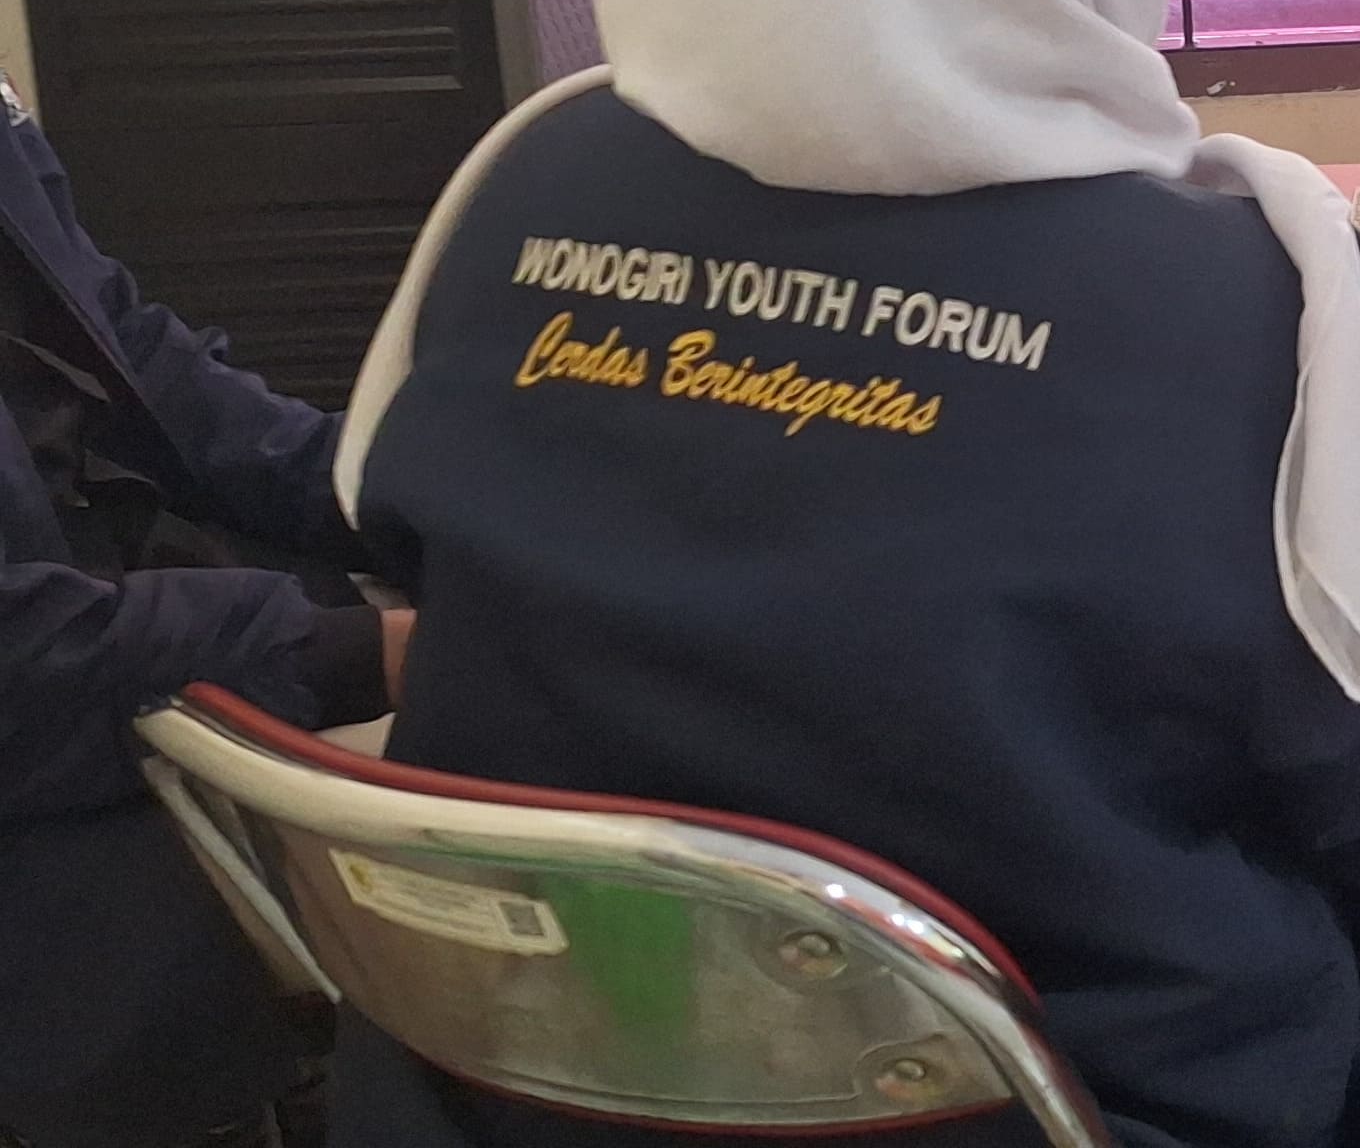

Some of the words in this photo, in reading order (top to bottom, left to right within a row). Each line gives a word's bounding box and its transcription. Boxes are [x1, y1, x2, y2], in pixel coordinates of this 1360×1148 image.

[512, 236, 693, 305] WONOGIRI
[704, 258, 858, 331] YOUTH
[861, 285, 1053, 371] FORUM
[515, 312, 647, 387] Cerdas
[661, 329, 942, 435] Berintegritas
